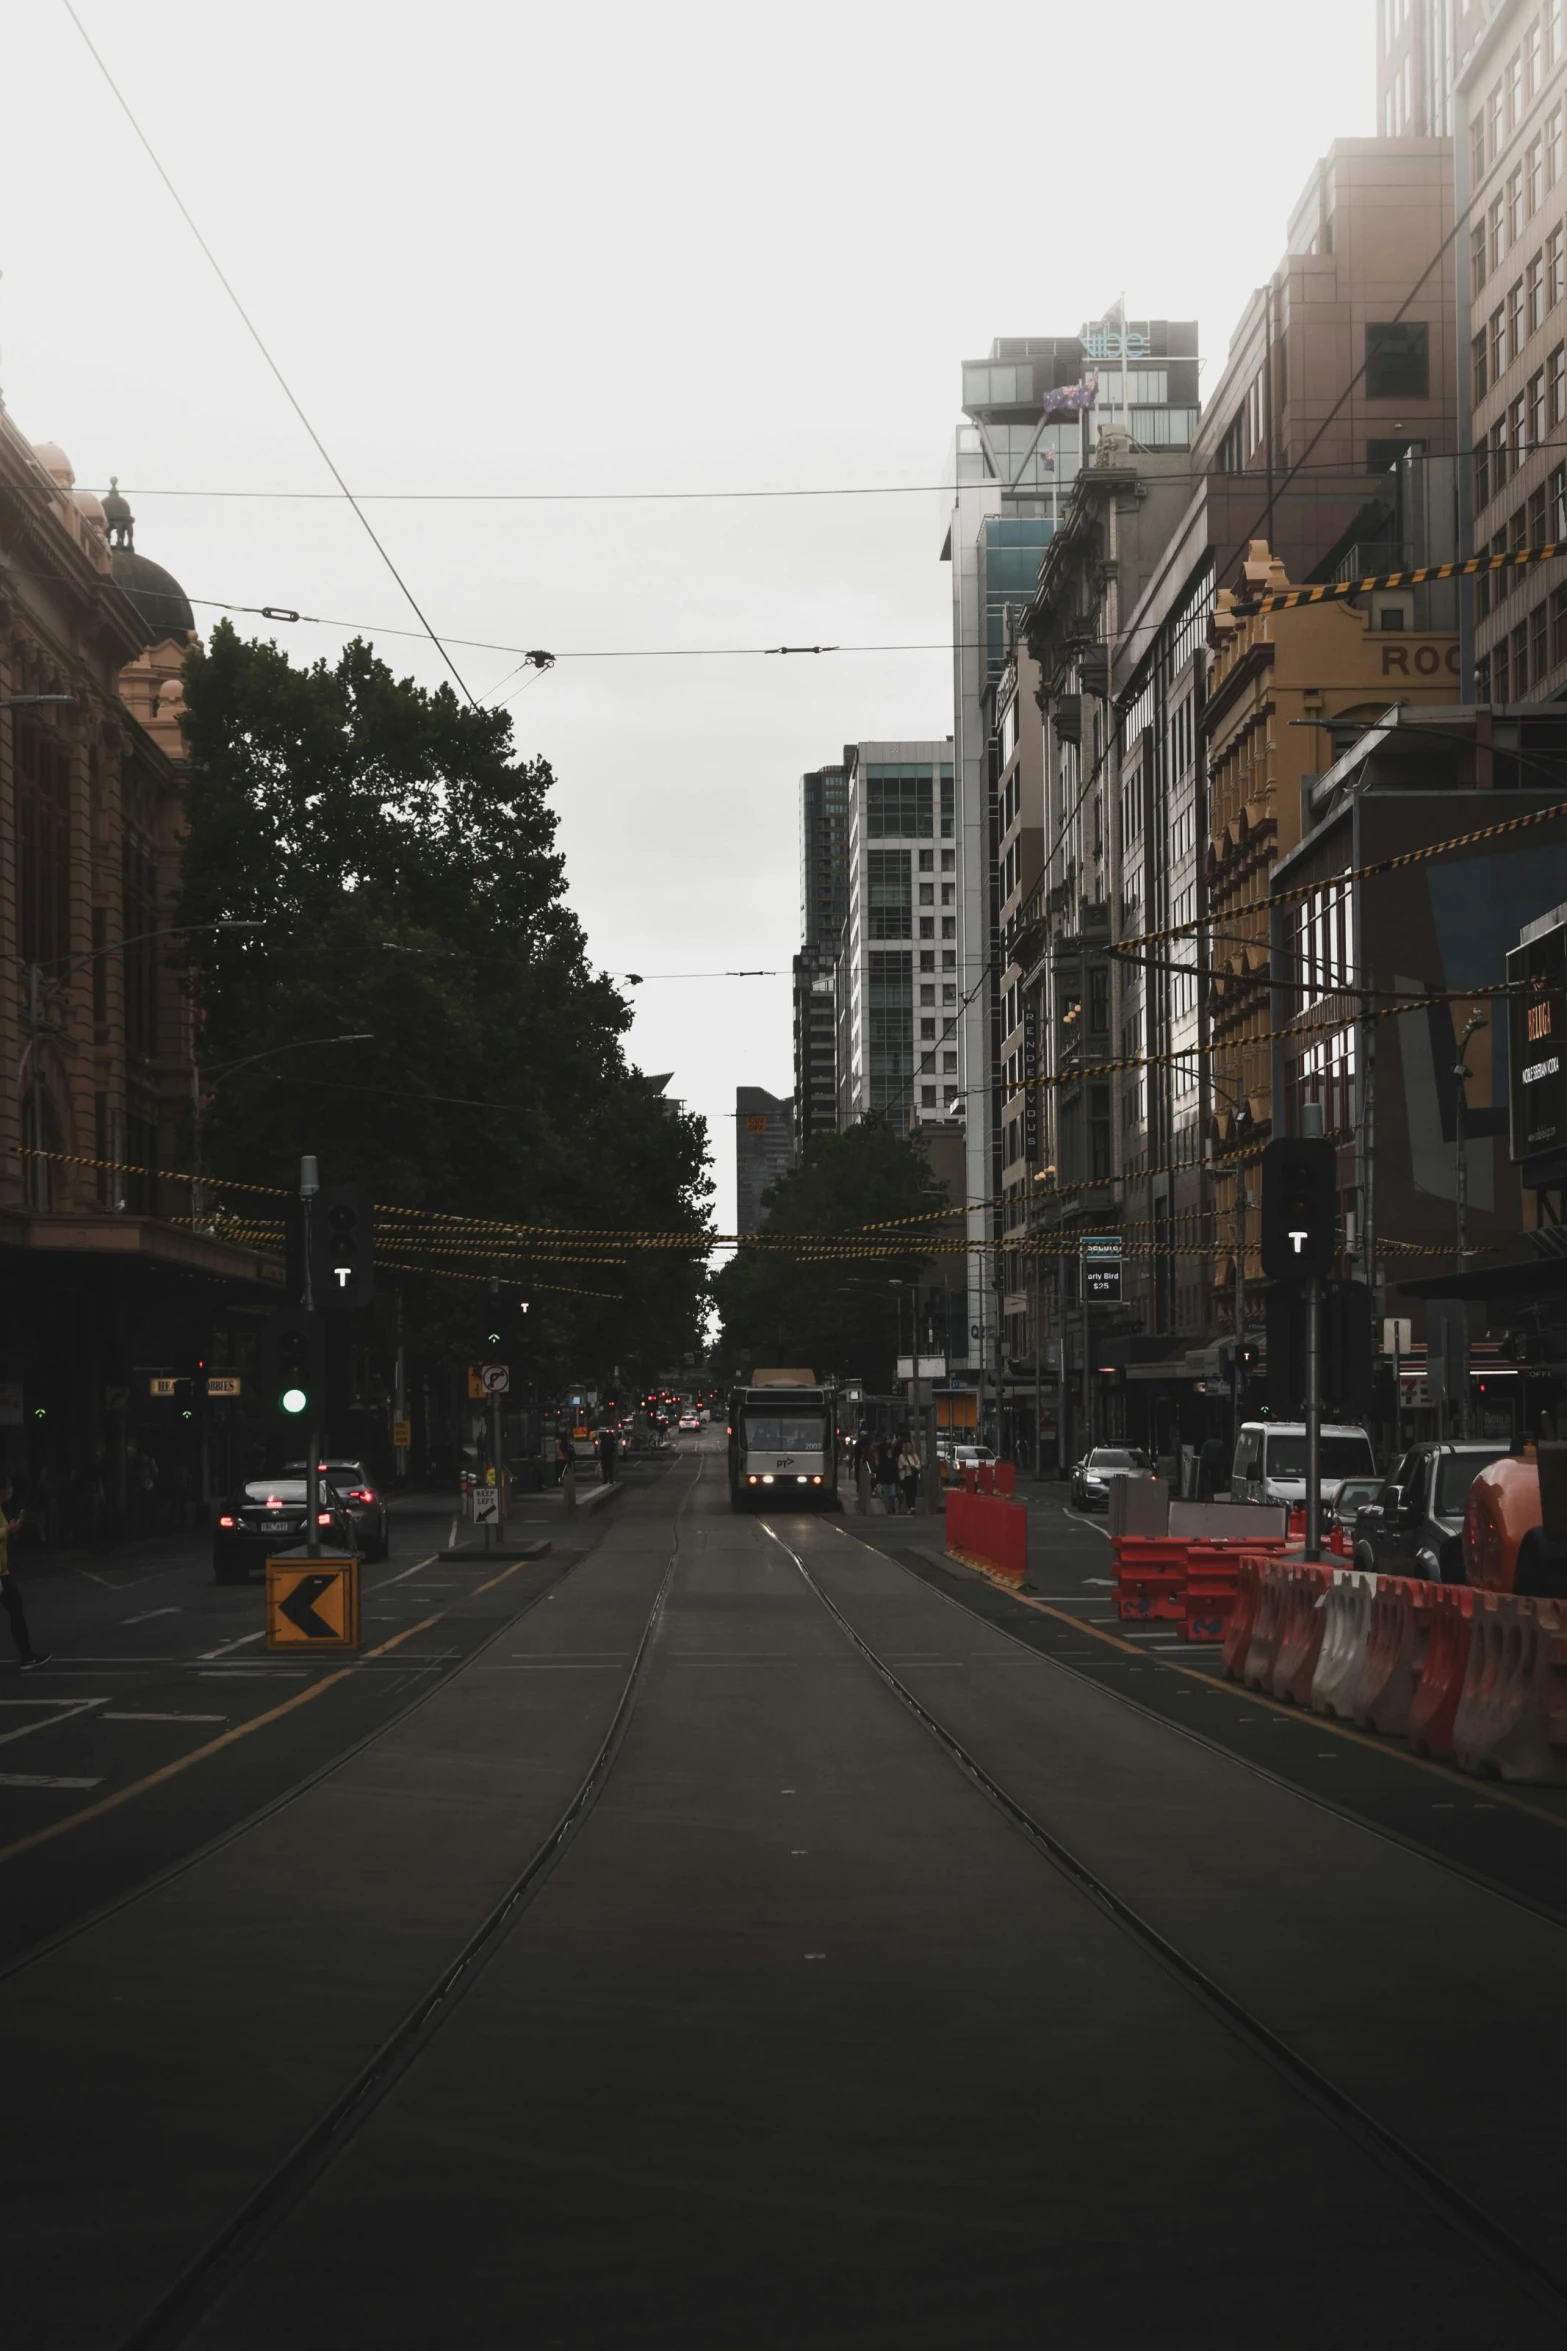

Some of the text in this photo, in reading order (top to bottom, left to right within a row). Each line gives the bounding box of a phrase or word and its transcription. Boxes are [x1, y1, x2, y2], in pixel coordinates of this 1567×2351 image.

[1078, 327, 1145, 358] vibe
[1528, 1000, 1551, 1042] BELUGA
[1026, 1013, 1037, 1145] RENDEVOUS
[1104, 1272, 1119, 1280] Bird
[1093, 1282, 1110, 1291] $25
[208, 1381, 234, 1391] BBIES
